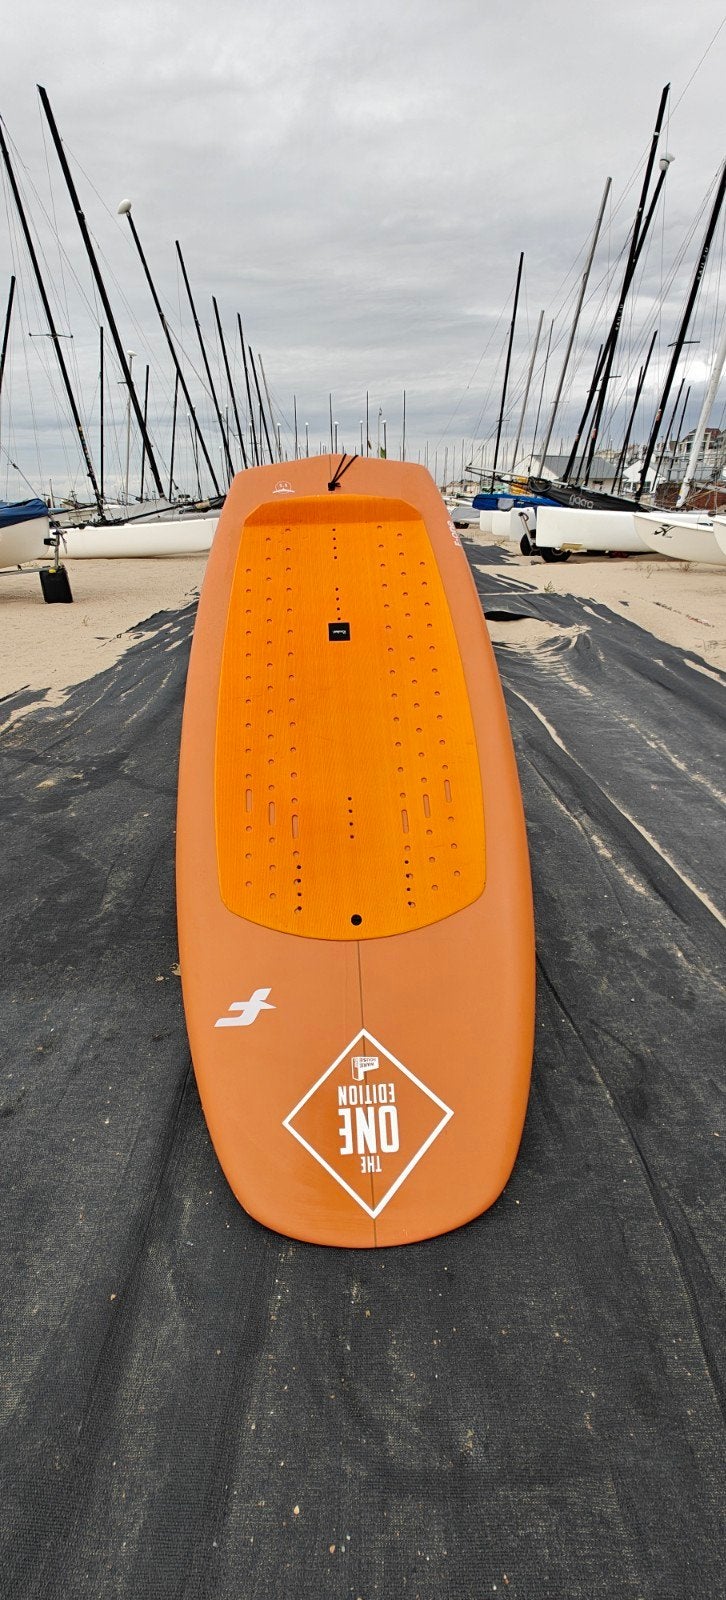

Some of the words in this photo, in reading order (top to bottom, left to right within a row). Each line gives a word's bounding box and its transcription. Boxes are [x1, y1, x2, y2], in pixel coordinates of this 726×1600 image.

[338, 1083, 396, 1106] EDITION
[338, 1105, 400, 1156] ONE
[360, 1155, 382, 1174] THE
